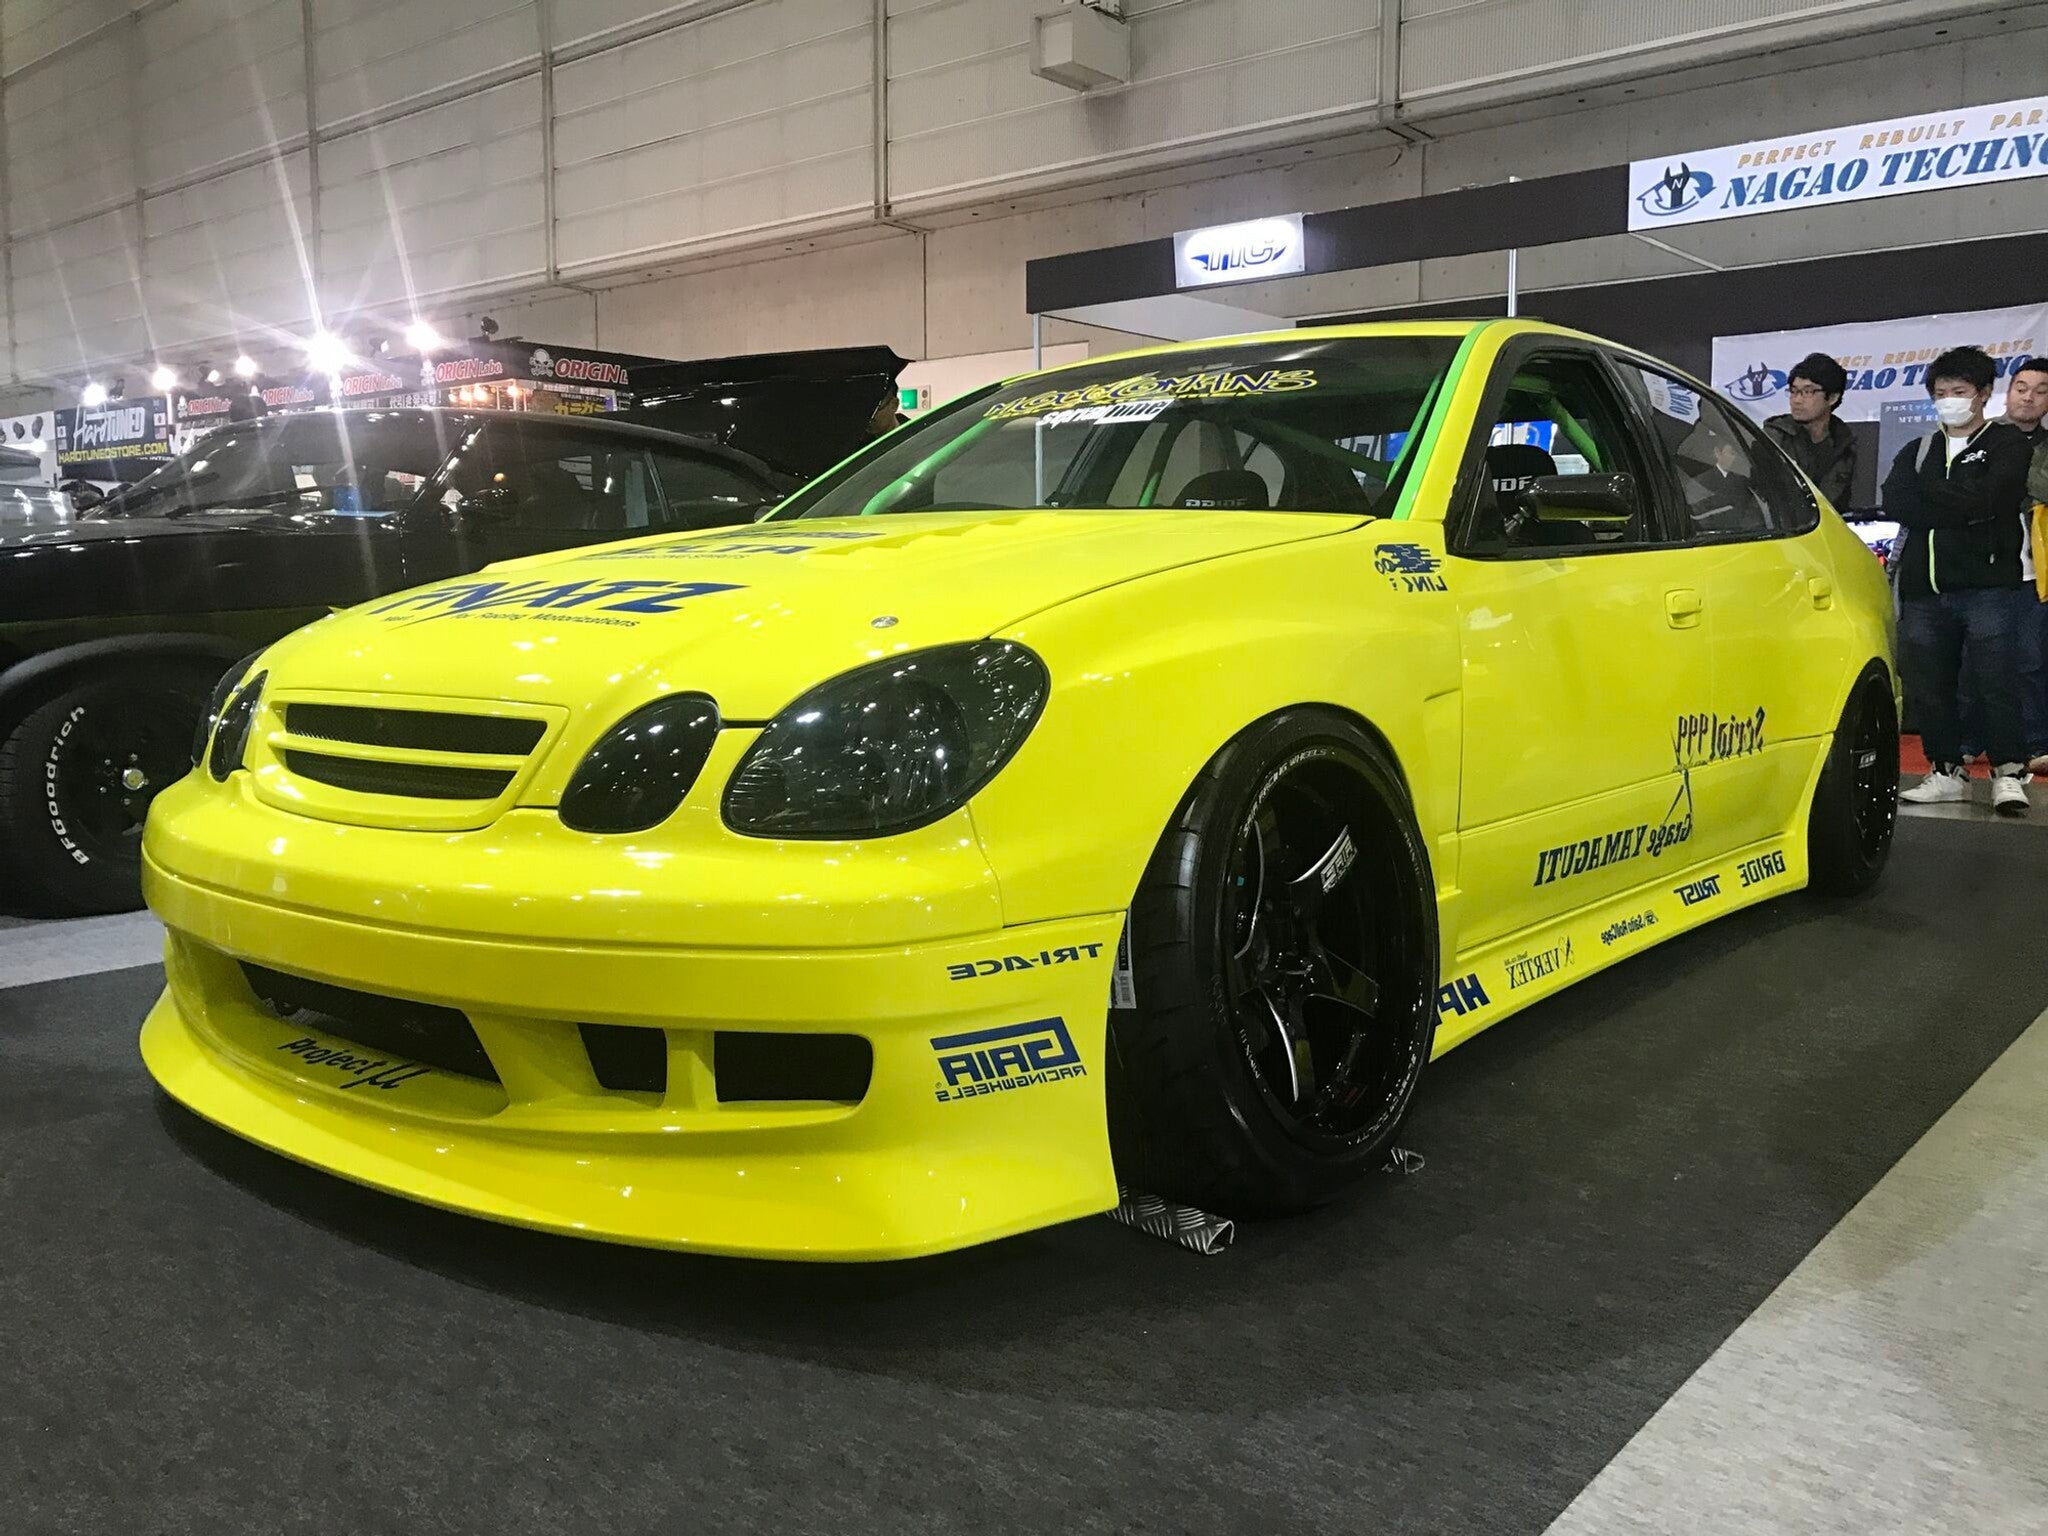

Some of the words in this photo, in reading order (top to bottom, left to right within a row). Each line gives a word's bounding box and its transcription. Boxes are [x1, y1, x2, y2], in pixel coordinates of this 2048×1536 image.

[1737, 140, 1836, 169] PERFECT
[1859, 119, 1965, 150] REBUILT
[1989, 109, 2048, 131] PAR
[1720, 158, 1868, 210] NAGAO
[1883, 347, 1948, 365] REBUI
[1984, 339, 2034, 356] ARTS
[435, 358, 480, 383] ORIGIN
[555, 358, 621, 383] ORIGIN
[1844, 367, 1898, 391] GAO
[261, 386, 295, 407] ORIGIN
[342, 373, 382, 396] ORIGIN
[58, 441, 168, 464] HARDTUNEDSTORE.COM
